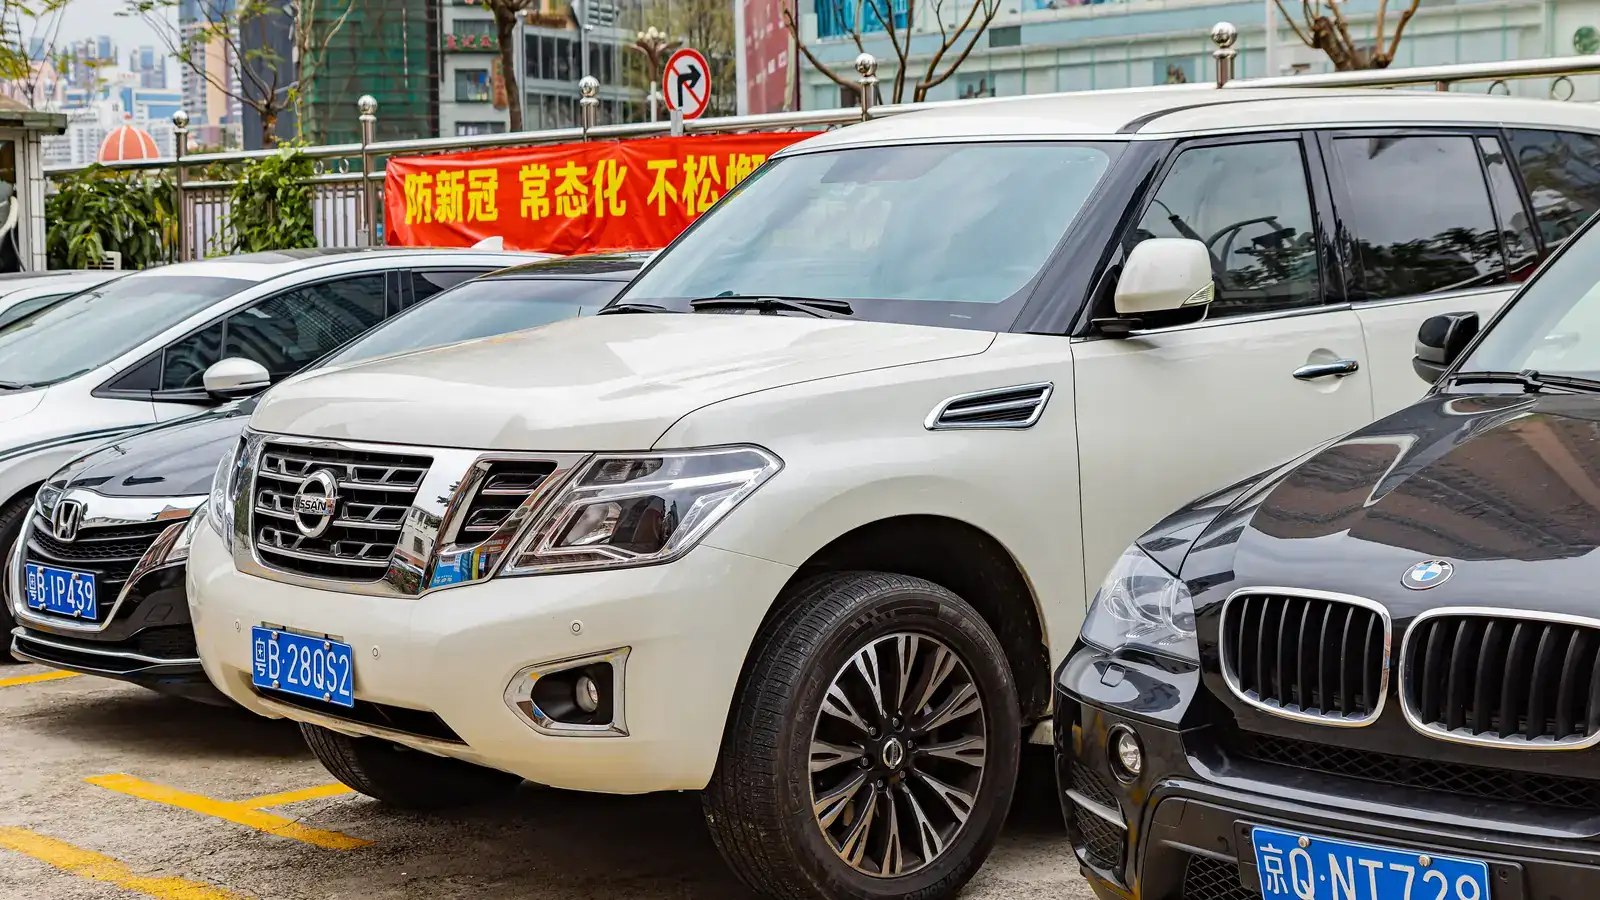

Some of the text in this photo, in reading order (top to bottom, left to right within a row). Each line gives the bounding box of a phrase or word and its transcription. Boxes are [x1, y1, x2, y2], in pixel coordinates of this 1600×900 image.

[404, 168, 499, 225] 防新冠
[519, 159, 628, 220] 常态化
[255, 637, 350, 697] 粤B·28QS2
